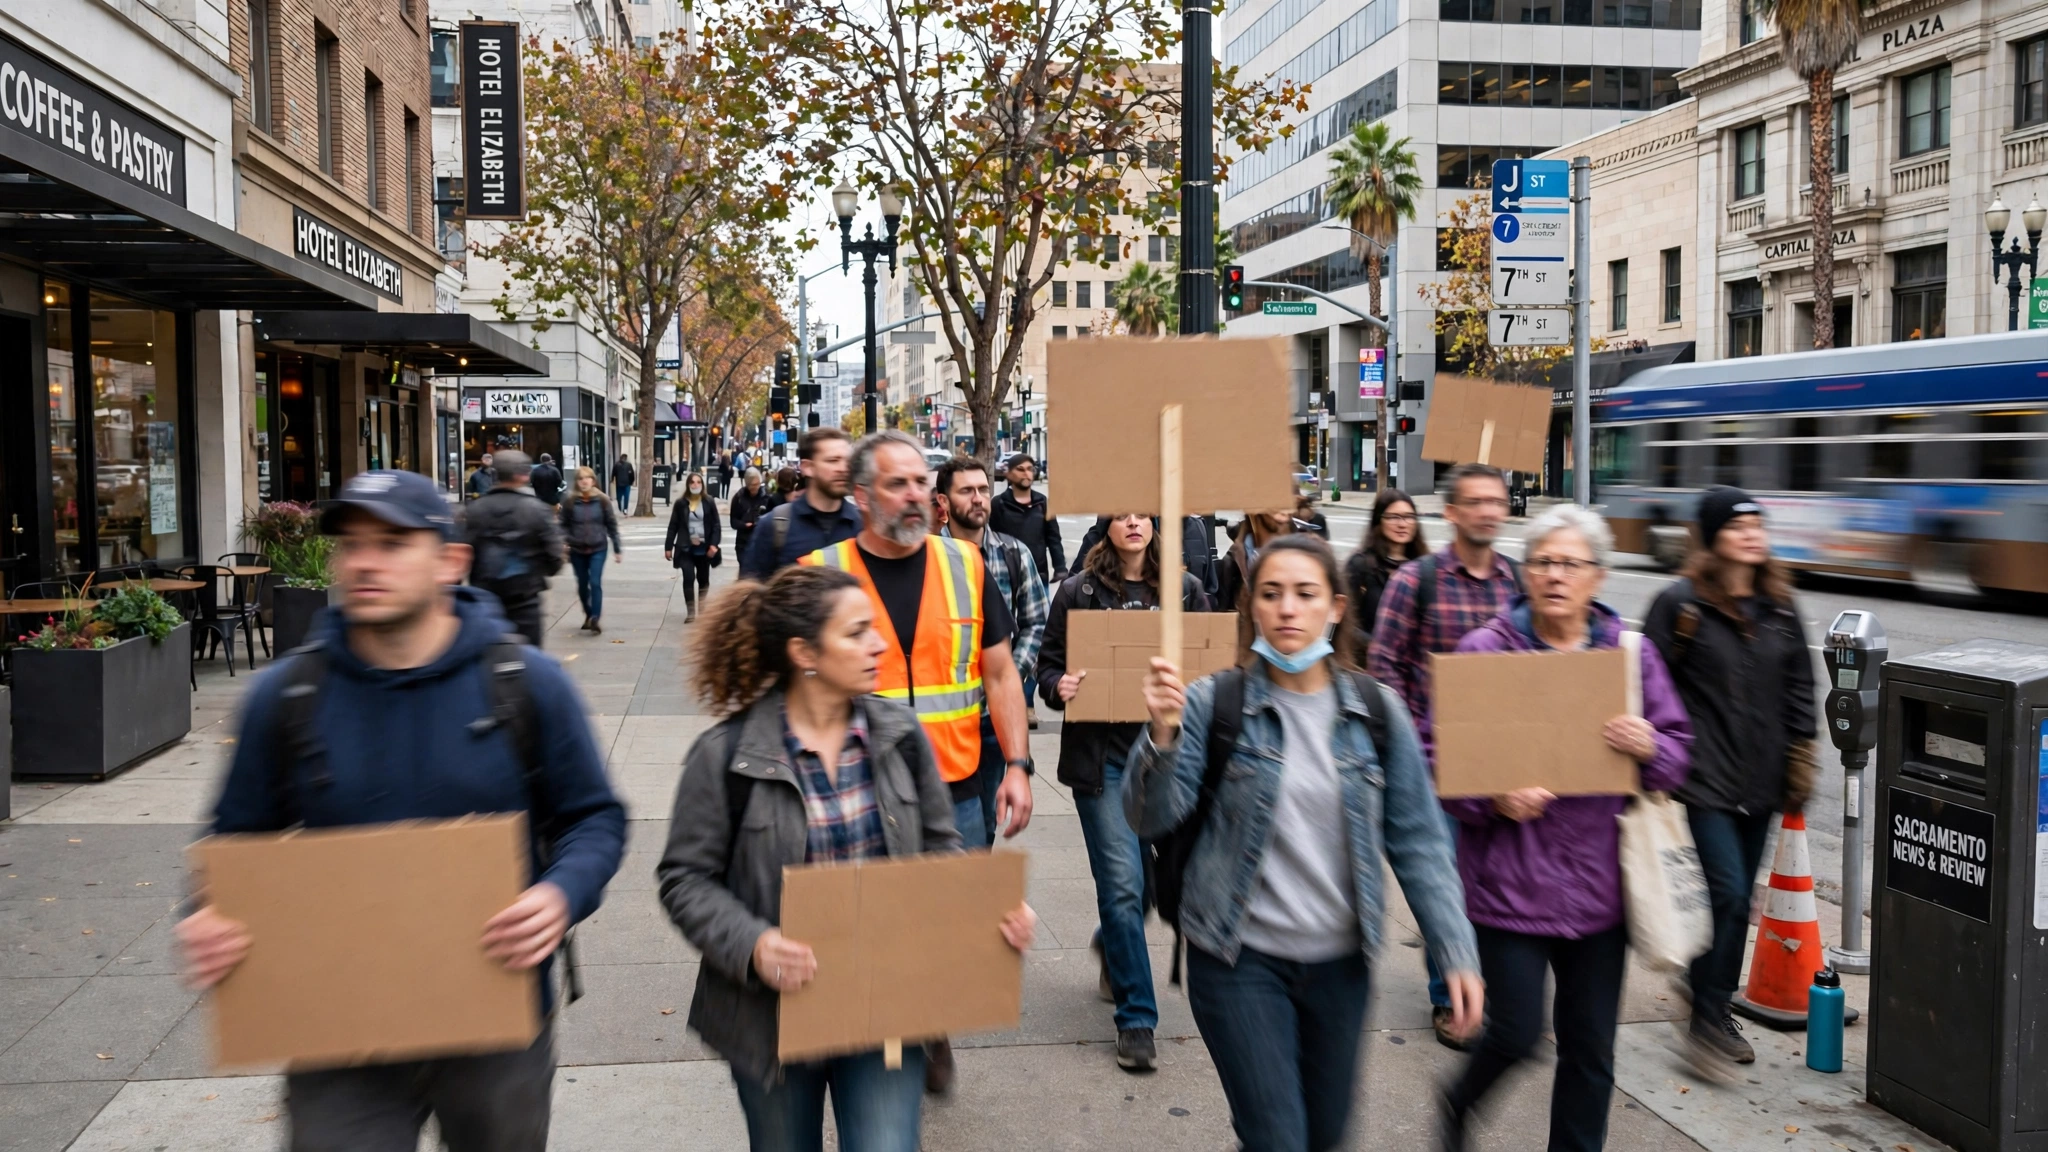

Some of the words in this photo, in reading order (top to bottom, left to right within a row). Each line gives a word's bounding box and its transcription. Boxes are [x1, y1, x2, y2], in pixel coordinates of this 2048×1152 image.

[1883, 14, 1944, 52] PLAZA
[478, 38, 502, 97] HOTEL
[0, 62, 86, 154] COFFEE
[91, 110, 106, 163] &
[110, 119, 173, 194] PASTRY
[480, 108, 505, 204] ELIZABETH
[1501, 165, 1518, 193] J
[1530, 175, 1546, 187] ST
[1502, 220, 1511, 238] 7
[1765, 238, 1810, 259] CAPITAL
[1832, 229, 1856, 245] AZA
[297, 216, 342, 270] HOTEL
[345, 240, 401, 297] ELIZABETH
[1500, 267, 1529, 297] 7TH
[1535, 272, 1547, 283] ST
[1499, 314, 1528, 343] 7TH
[1536, 318, 1547, 329] ST
[1893, 814, 1986, 862] SACRAMENTO
[1893, 839, 1925, 867] NEWS
[1927, 851, 1936, 871] &
[1940, 854, 1986, 886] REVIEW
